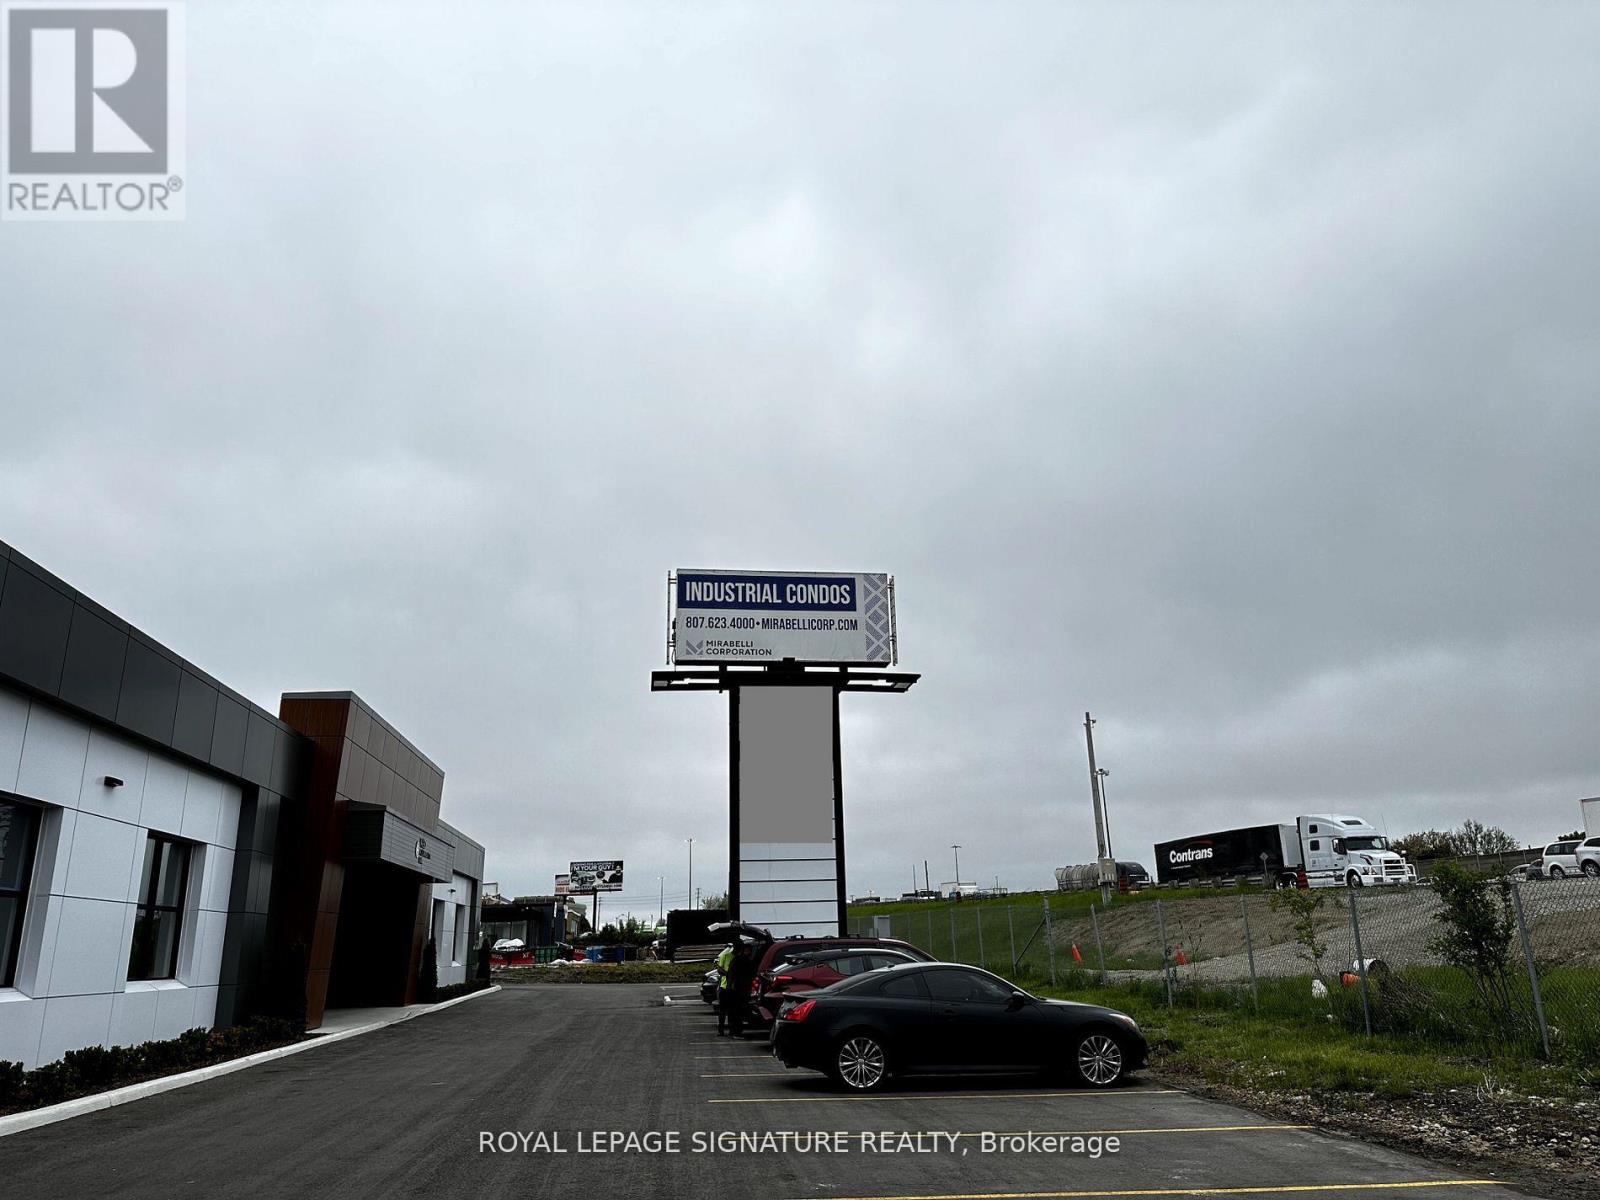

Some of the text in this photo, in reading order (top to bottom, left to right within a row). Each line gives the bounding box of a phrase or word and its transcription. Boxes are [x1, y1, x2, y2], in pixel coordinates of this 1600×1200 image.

[685, 581, 851, 604] INDUSTRIAL CONDOS
[706, 640, 754, 648] MIRABELLI
[706, 648, 772, 656] CORPORATION
[1169, 847, 1213, 864] Contrans
